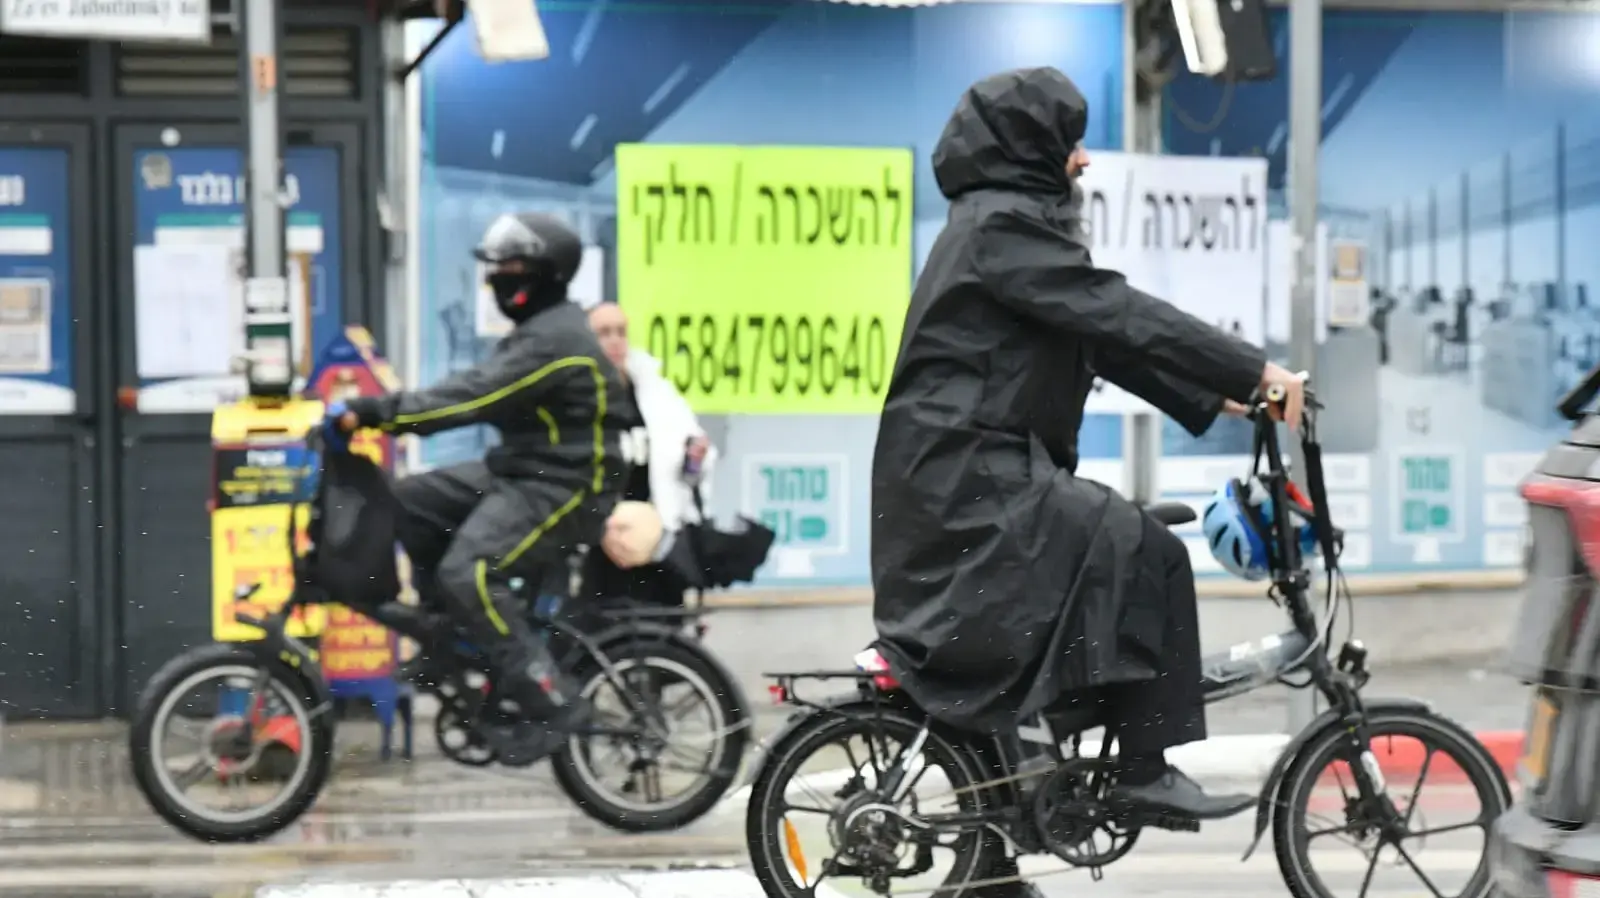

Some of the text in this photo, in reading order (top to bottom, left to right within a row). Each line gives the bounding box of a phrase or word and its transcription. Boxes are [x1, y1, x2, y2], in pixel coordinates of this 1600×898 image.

[633, 161, 901, 266] להשכרה / חלקי
[1142, 173, 1258, 251] להשכרה
[649, 314, 887, 396] 0584799640
